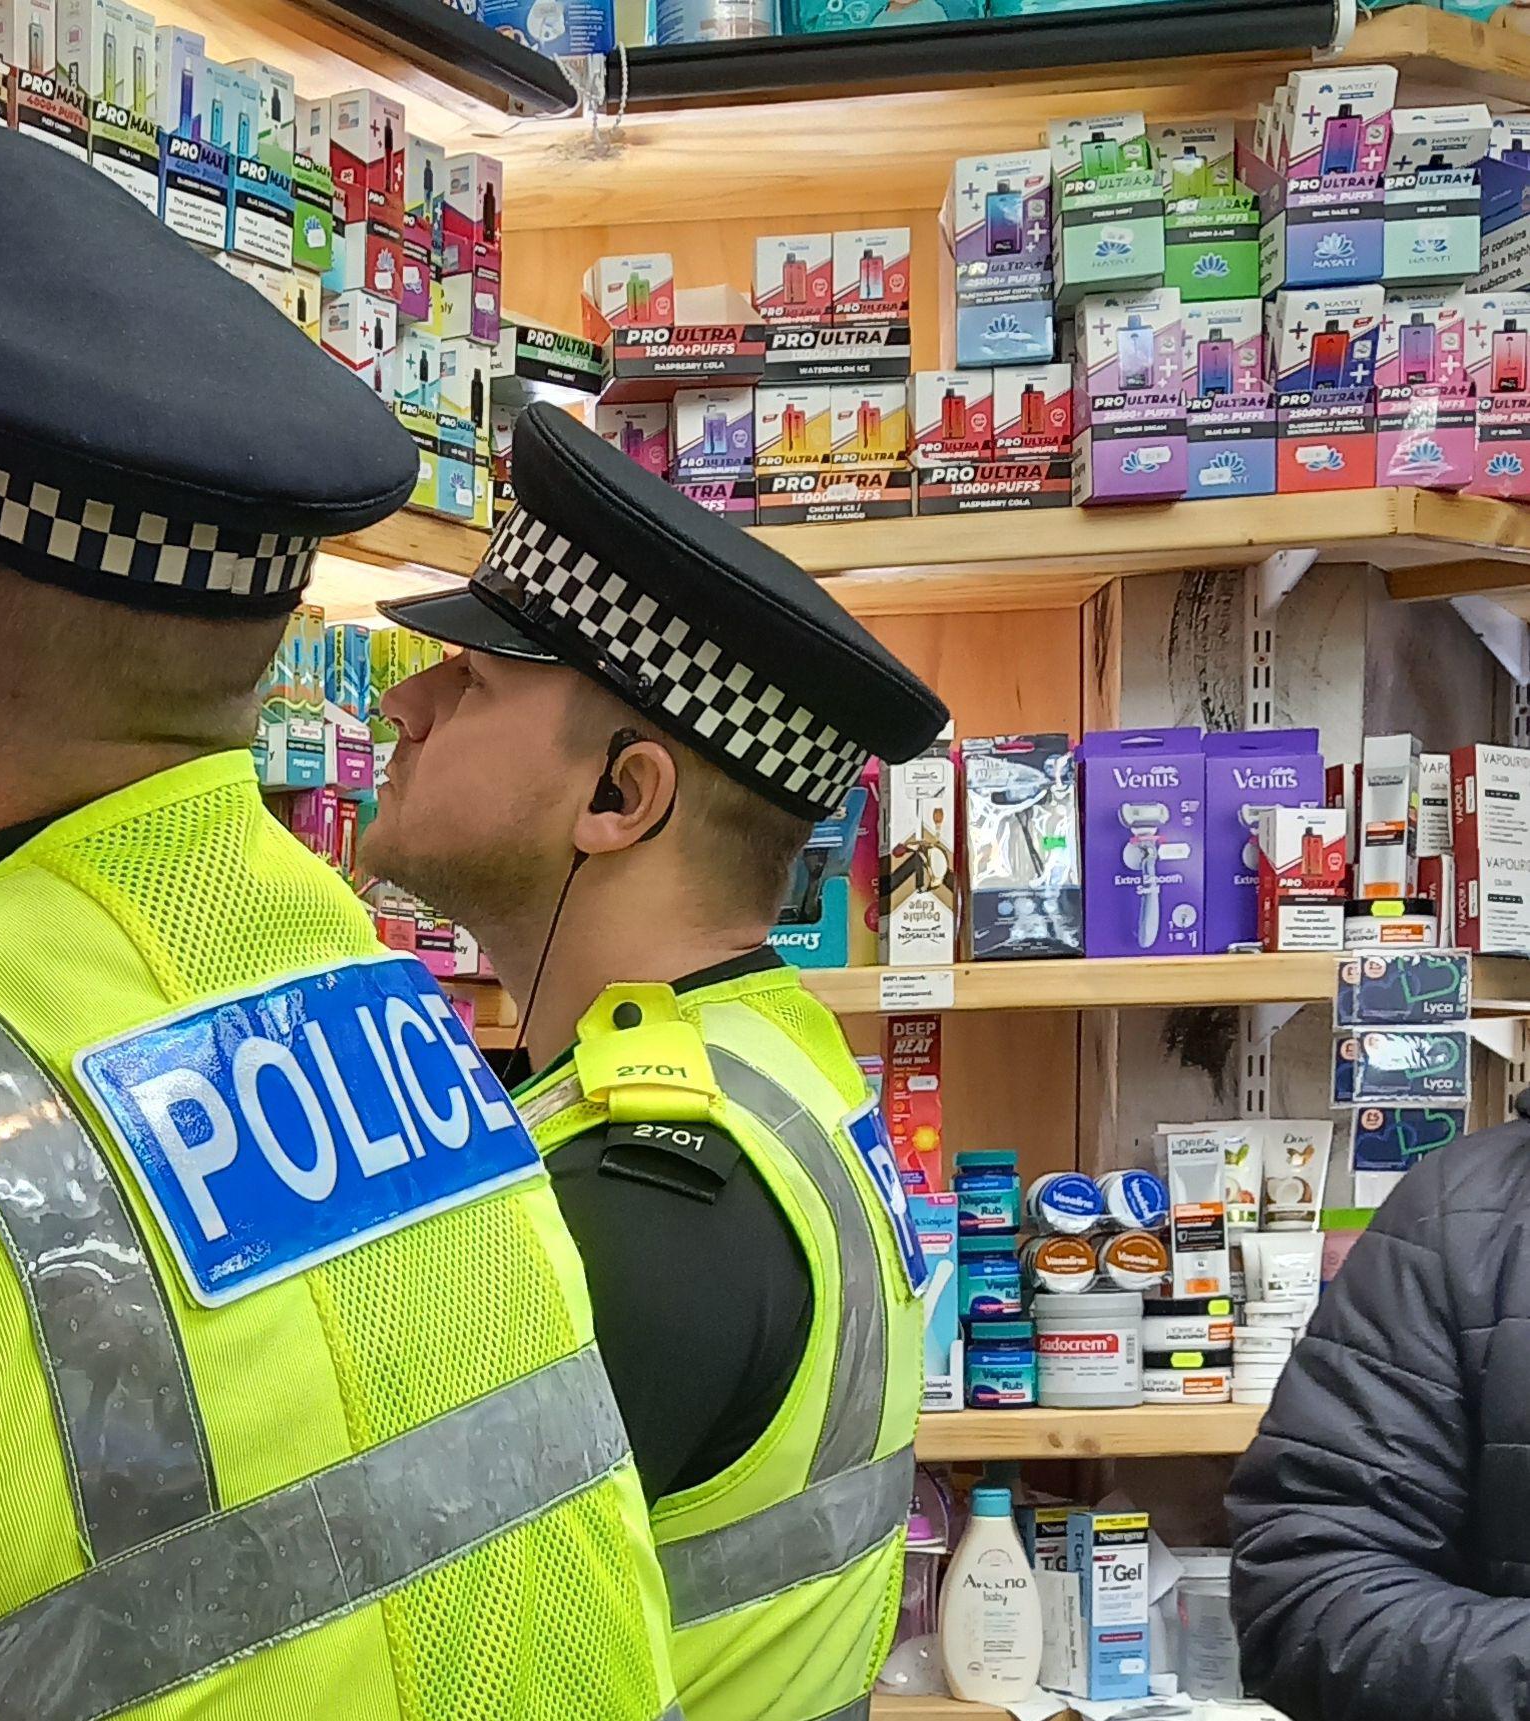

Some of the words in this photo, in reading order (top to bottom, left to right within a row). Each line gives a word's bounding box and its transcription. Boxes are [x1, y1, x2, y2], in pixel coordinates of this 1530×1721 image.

[20, 73, 53, 97] PRO
[96, 103, 129, 127] PRO
[131, 114, 156, 138] MAX
[170, 138, 198, 160] PRO
[201, 147, 225, 169] MAX
[239, 159, 267, 181] PRO
[1290, 180, 1320, 192] PRO
[1323, 176, 1375, 189] ULTRA+
[1386, 177, 1415, 189] PRO
[1418, 173, 1471, 185] ULTRA+
[527, 328, 554, 348] PRO
[556, 339, 590, 358] ULTRA
[626, 328, 670, 345] PRO
[674, 326, 738, 344] ULTRA
[771, 332, 816, 349] PRO
[819, 329, 883, 346] ULTRA
[1094, 395, 1125, 409] PRO
[1127, 392, 1177, 406] ULTRA+
[1281, 394, 1310, 407] PRO
[772, 475, 816, 493] PRO
[931, 467, 975, 484] PRO
[979, 464, 1042, 482] ULTRA
[1113, 767, 1179, 789] Venus
[1233, 768, 1299, 789] Venus
[1423, 1001, 1454, 1014] Lyca
[892, 1021, 936, 1038] DEEP
[616, 1064, 688, 1080] 2701
[1423, 1078, 1454, 1090] Lyca
[130, 993, 518, 1242] POLICE
[633, 1123, 707, 1152] 2701
